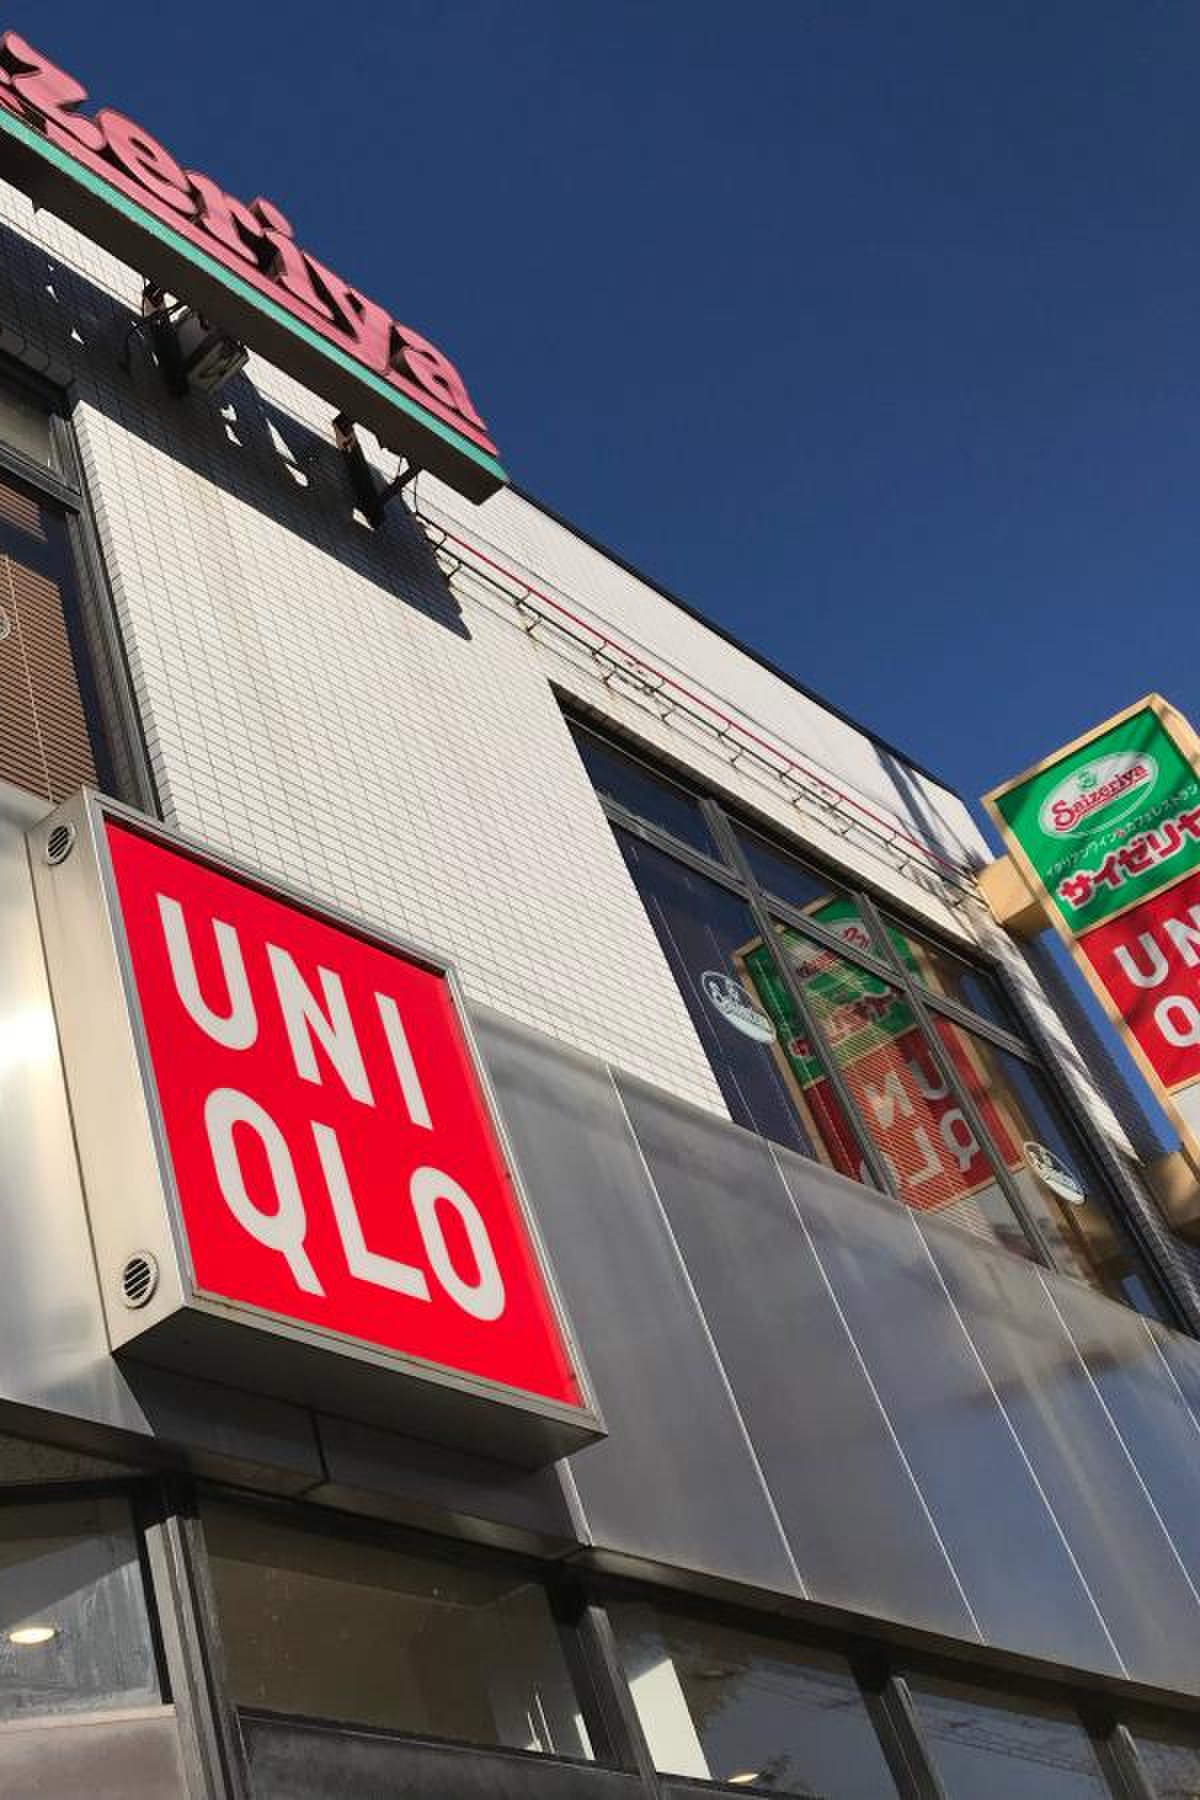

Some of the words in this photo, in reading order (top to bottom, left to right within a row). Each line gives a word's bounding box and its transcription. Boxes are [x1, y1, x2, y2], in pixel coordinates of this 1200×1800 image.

[1051, 764, 1149, 832] Saizeriya
[157, 893, 432, 1130] UNI
[204, 1087, 506, 1321] QLO
